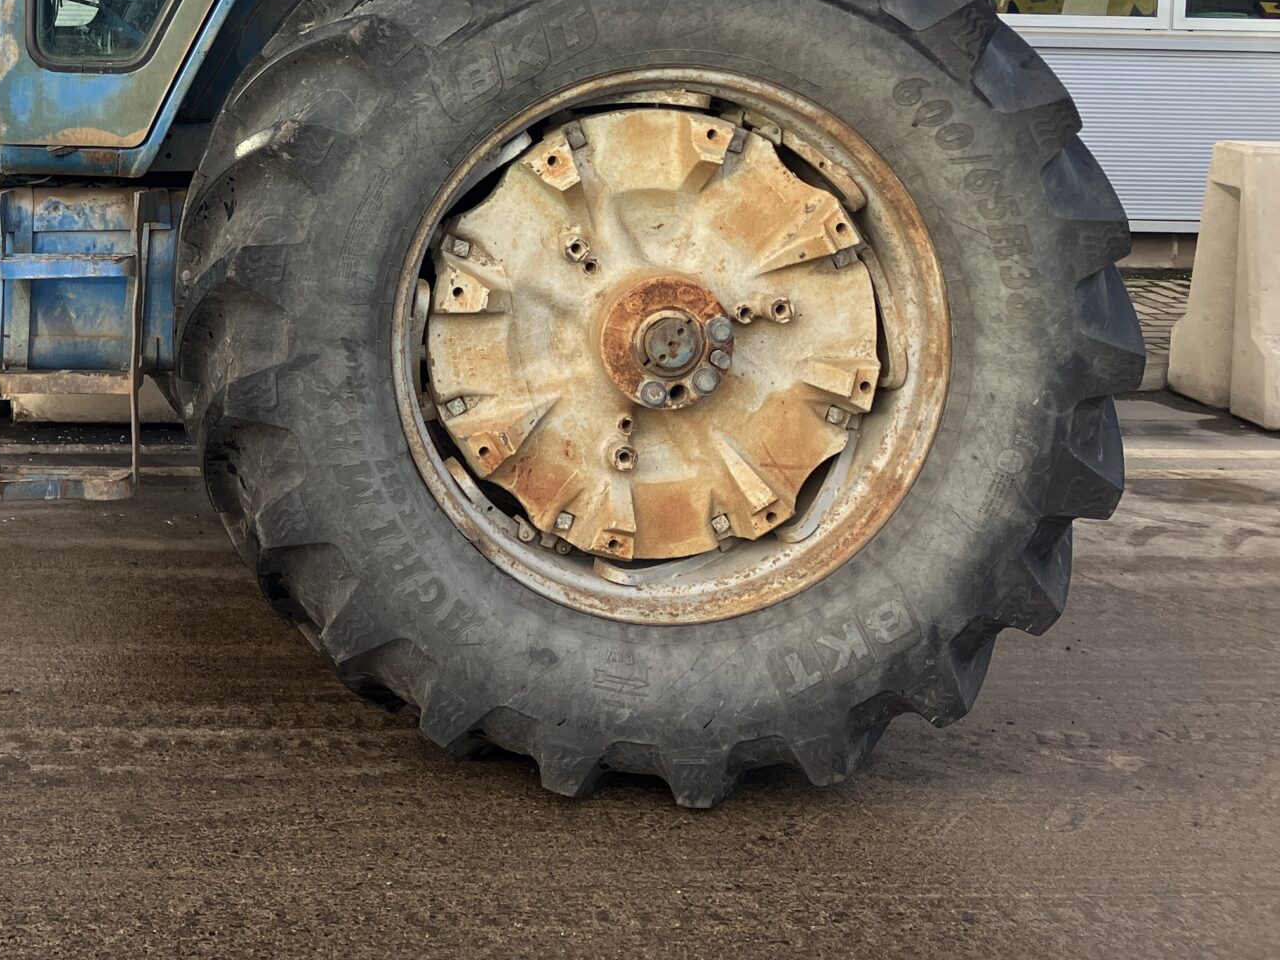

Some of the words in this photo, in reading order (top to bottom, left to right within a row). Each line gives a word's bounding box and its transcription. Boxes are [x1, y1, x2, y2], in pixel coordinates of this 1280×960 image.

[454, 4, 590, 104] BKT
[892, 77, 1048, 321] 600/65R38
[783, 597, 915, 699] BKT
